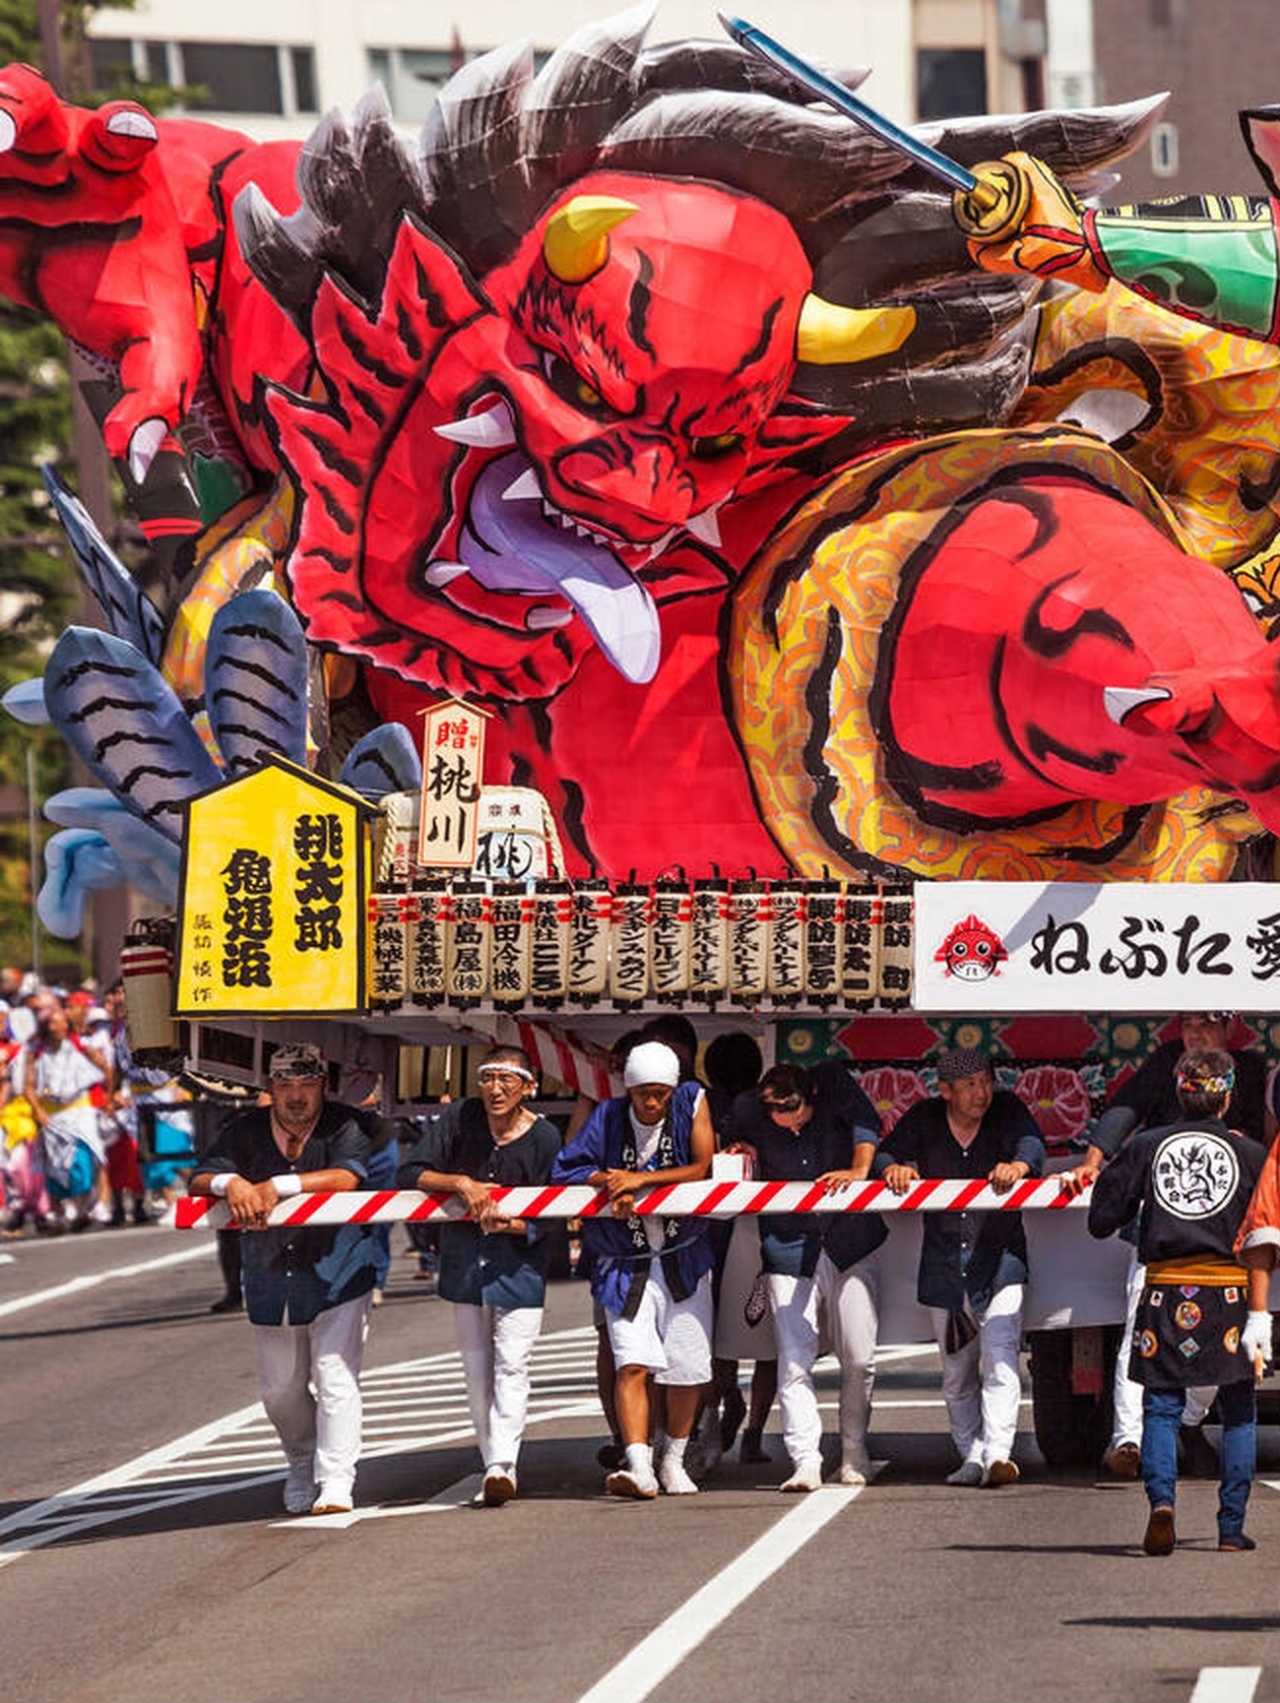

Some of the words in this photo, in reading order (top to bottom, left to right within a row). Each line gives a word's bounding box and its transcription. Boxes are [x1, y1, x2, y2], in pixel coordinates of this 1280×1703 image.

[435, 718, 469, 750] 贈
[427, 753, 481, 854] 桃川
[219, 848, 274, 987] 鬼退治
[293, 813, 344, 953] 桃太郎
[373, 898, 403, 993] 三戸機械工業
[453, 897, 484, 991] 福島屋(株)
[492, 898, 521, 991] 福田冷機
[569, 895, 599, 986] 東北ダイケン
[652, 898, 683, 988] 日本ビルコン
